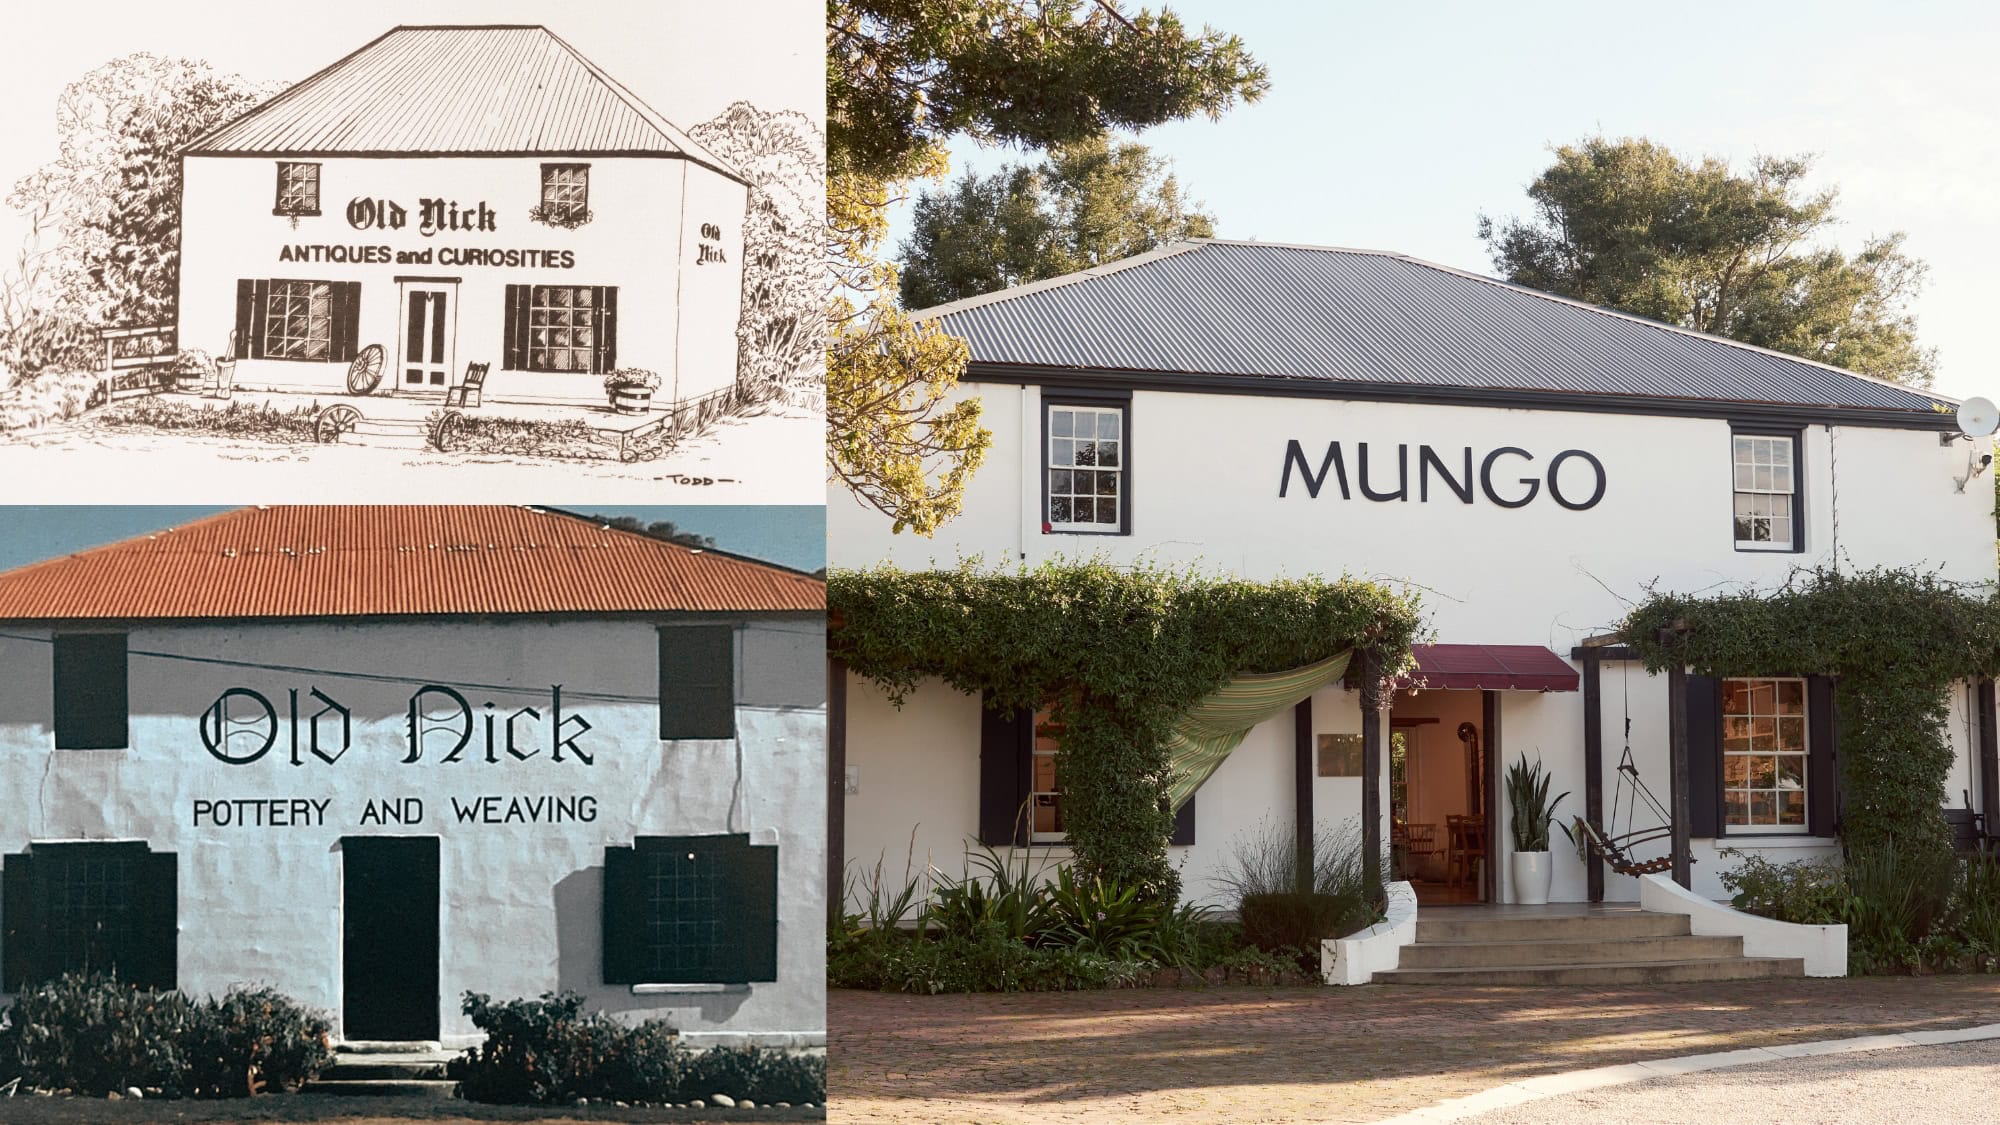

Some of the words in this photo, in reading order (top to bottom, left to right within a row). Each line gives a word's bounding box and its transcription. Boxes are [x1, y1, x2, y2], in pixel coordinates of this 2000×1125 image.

[347, 197, 407, 231] Old
[419, 198, 497, 237] Nick
[701, 223, 720, 241] Old
[279, 245, 392, 264] ANTIQUES
[396, 248, 433, 265] and
[438, 248, 575, 269] CURIOSITIES
[696, 243, 727, 266] Nick
[1279, 440, 1606, 511] MUNGO
[200, 686, 351, 766] Old
[402, 684, 594, 766] Nick
[193, 798, 332, 827] POTTERY
[359, 797, 423, 825] AND
[450, 795, 598, 824] WEAVING
